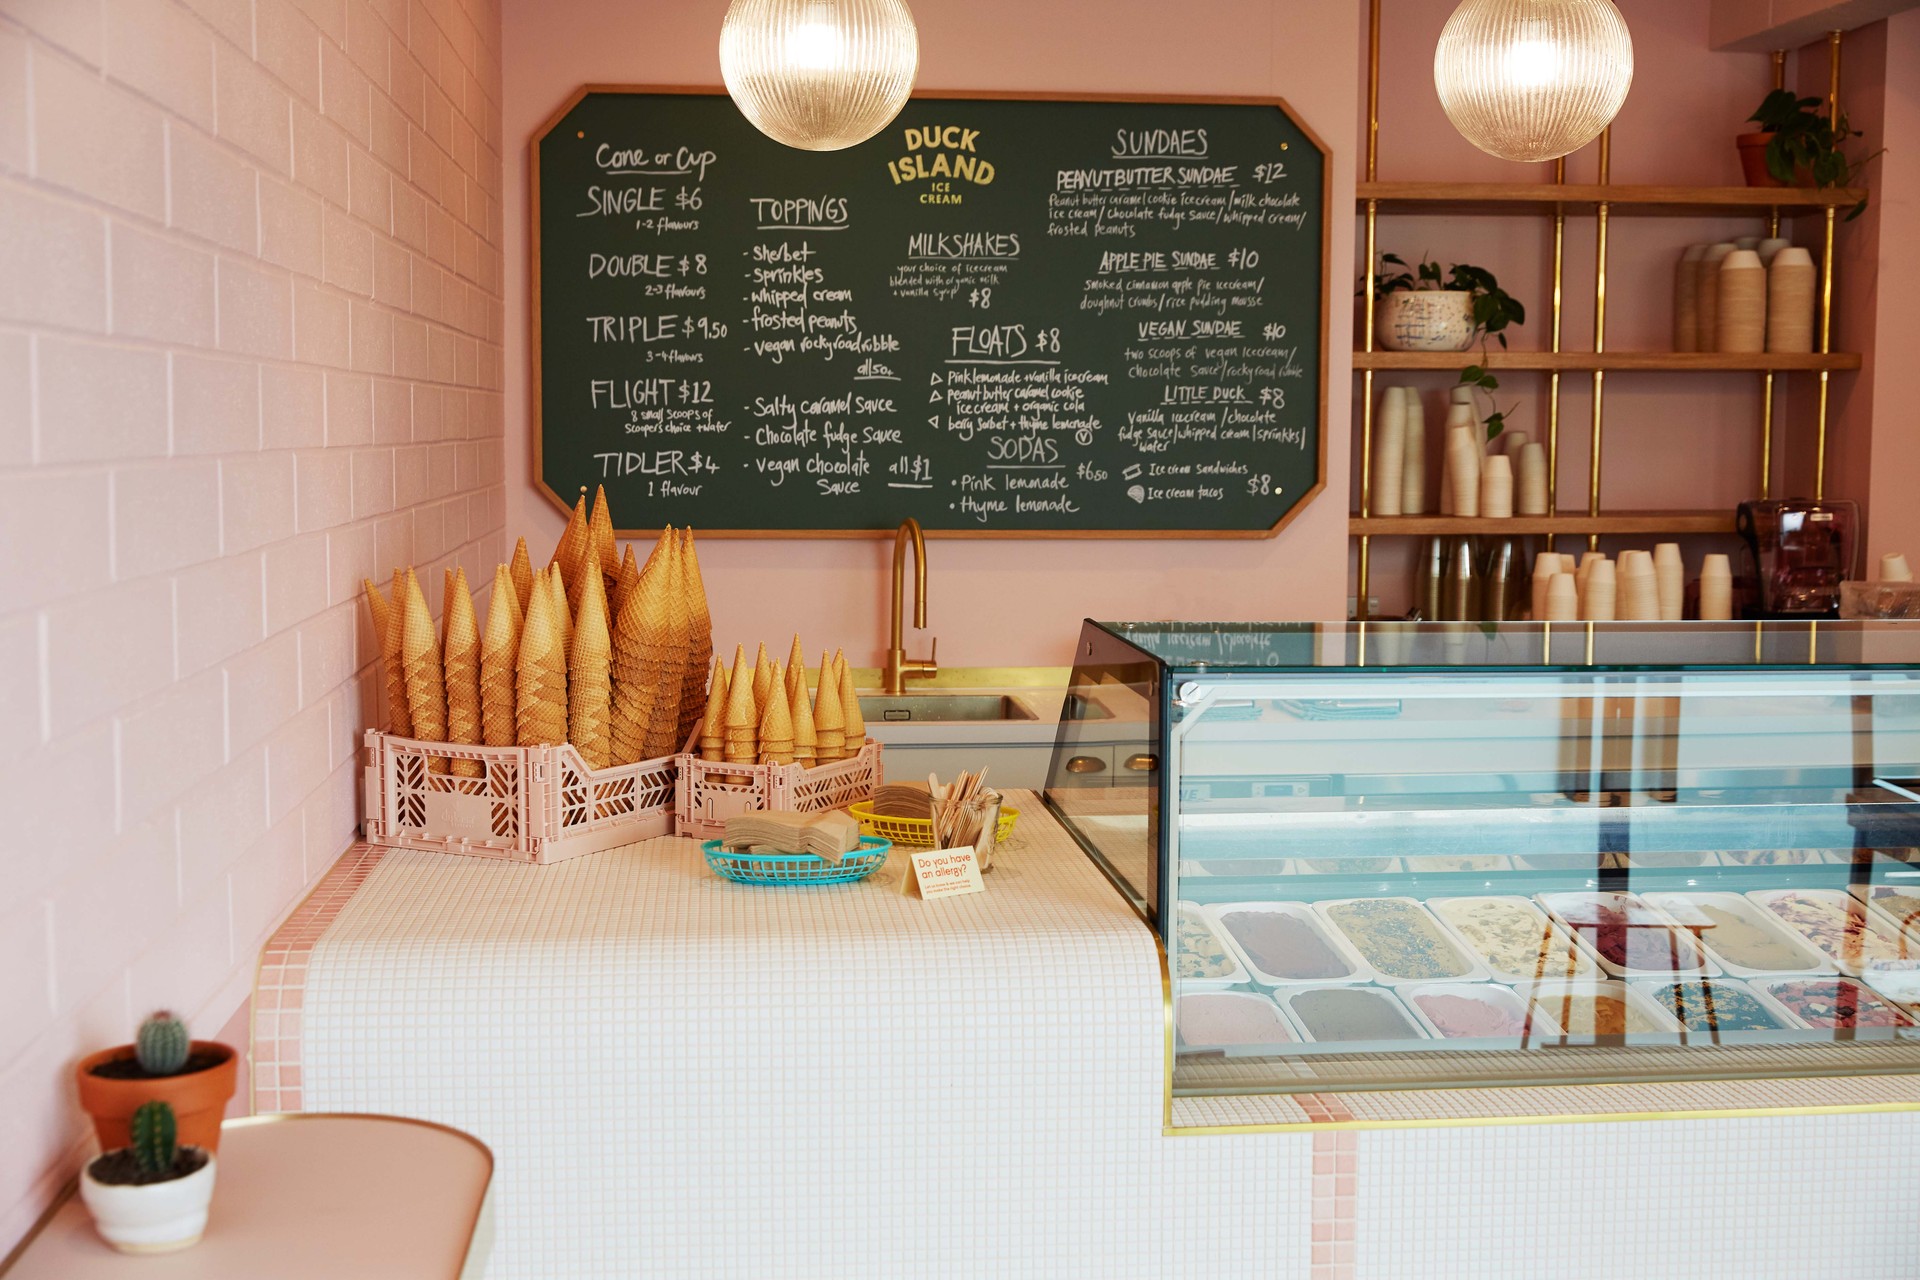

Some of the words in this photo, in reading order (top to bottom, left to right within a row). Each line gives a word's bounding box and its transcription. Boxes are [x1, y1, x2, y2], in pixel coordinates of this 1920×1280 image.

[905, 125, 980, 153] DUCK
[1111, 128, 1208, 157] SUNDAES
[596, 143, 649, 168] Cone
[655, 153, 672, 165] or
[676, 146, 717, 182] Cup
[888, 153, 995, 185] ISLAND
[1177, 164, 1239, 185] SUNDAE
[1252, 163, 1288, 185] $12
[931, 182, 951, 193] ICE
[576, 186, 666, 217] SINGLE
[675, 186, 703, 210] $6
[750, 195, 849, 224] TOPPINGS
[919, 194, 962, 205] CREAM
[657, 216, 699, 236] flavours
[1047, 220, 1089, 237] frosted
[1095, 221, 1137, 238] peanuts
[1158, 207, 1184, 231] fudge
[589, 254, 675, 279] DOUBLE
[897, 263, 917, 278] your
[919, 262, 947, 273] choice
[951, 263, 962, 275] of
[1099, 250, 1141, 271] APPLE
[1143, 251, 1168, 269] PIE
[1172, 250, 1218, 269] SUNDAE
[1228, 248, 1260, 271] $10
[665, 283, 706, 300] flavours
[889, 275, 923, 287] blended
[1084, 277, 1123, 291] smoked
[751, 281, 808, 310] whipped
[813, 289, 853, 302] cream
[901, 287, 929, 298] vanilla
[968, 287, 992, 309] $8
[1190, 294, 1227, 316] pudding
[1231, 295, 1263, 306] mousse
[586, 315, 678, 344] TRIPLE
[682, 316, 728, 340] $9.50
[751, 305, 805, 334] frosted
[808, 309, 858, 335] peanuts
[1138, 319, 1188, 340] VEGAN
[1192, 319, 1243, 337] SUNDAE
[1262, 322, 1287, 342] $10
[952, 324, 1028, 358] FLOATS
[1035, 327, 1061, 354] $8
[1124, 346, 1145, 361] two
[1148, 347, 1182, 366] scoops
[1185, 345, 1198, 360] of
[591, 378, 676, 409] FLIGHT
[678, 379, 714, 405] $12
[1164, 385, 1209, 403] LITTLE
[1213, 386, 1247, 401] DUCK
[1259, 386, 1286, 409] $8
[631, 410, 639, 423] 8
[641, 408, 664, 425] small
[702, 409, 714, 423] of
[753, 394, 798, 430] Salty
[801, 391, 852, 416] caramel
[1022, 400, 1060, 421] organic
[1063, 399, 1085, 414] cola
[665, 421, 692, 435] choice
[823, 420, 858, 455] fudge
[948, 416, 974, 441] berry
[1052, 413, 1103, 431] lemonade
[1118, 425, 1143, 447] fudge
[987, 435, 1060, 464] SODAS
[1139, 440, 1170, 453] wafer
[593, 450, 689, 478] TIDLER
[688, 451, 721, 475] $4
[888, 456, 908, 475] all
[911, 455, 933, 481] $1
[661, 480, 703, 498] flavour
[1005, 472, 1070, 491] lemonade
[1246, 473, 1272, 497] $8
[960, 495, 1009, 523] thyme
[1015, 494, 1080, 514] lemonade
[918, 859, 932, 869] Do
[933, 857, 949, 869] you
[949, 854, 971, 865] have
[921, 870, 934, 879] an
[935, 863, 967, 878] allergy?
